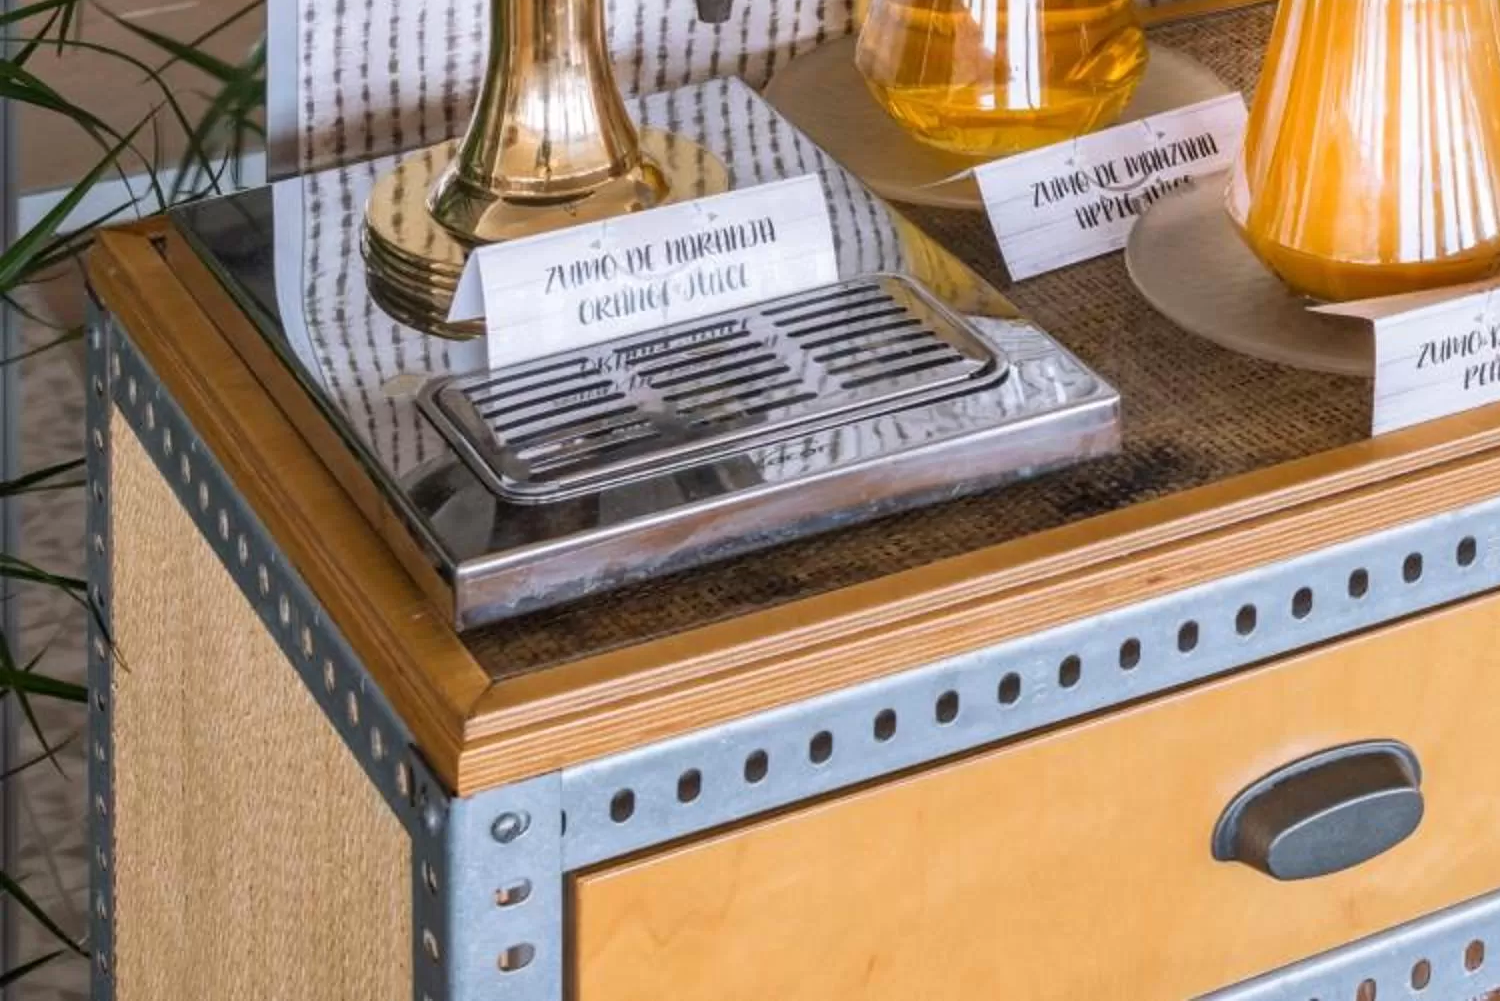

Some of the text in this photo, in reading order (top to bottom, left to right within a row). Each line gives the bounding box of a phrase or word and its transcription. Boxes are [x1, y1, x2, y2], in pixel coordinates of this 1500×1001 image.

[1030, 131, 1219, 208] ZUMO DE MANZANA
[545, 215, 777, 295] ZUMO DE NARANJA
[578, 262, 749, 325] ORANGE JUICE
[1416, 327, 1483, 369] ZUMO
